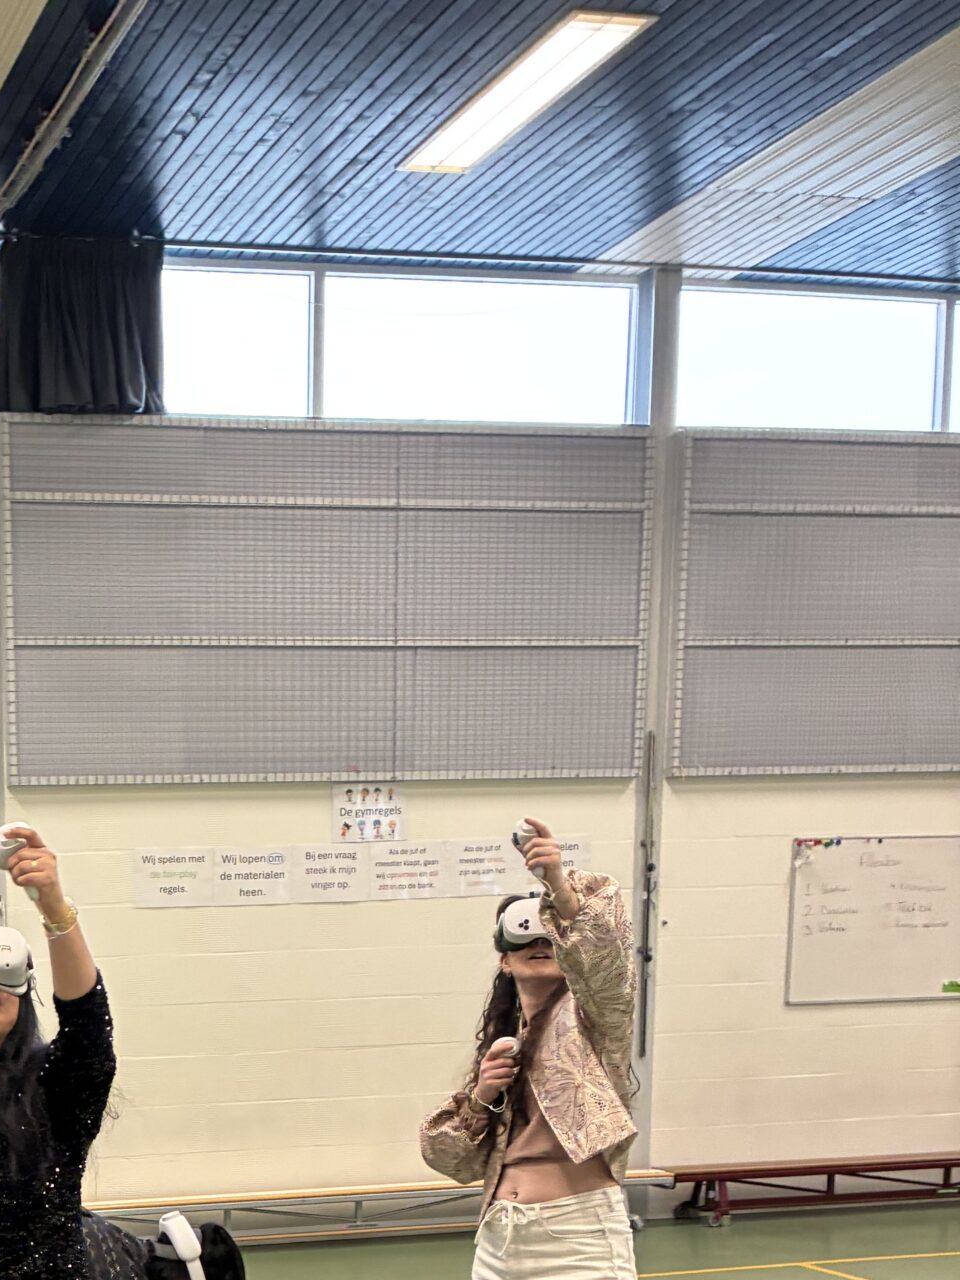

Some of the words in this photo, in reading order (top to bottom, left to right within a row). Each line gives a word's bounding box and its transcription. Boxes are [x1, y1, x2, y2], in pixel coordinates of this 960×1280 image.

[339, 807, 353, 817] De
[355, 805, 402, 818] gymregels
[141, 855, 156, 865] Wij
[157, 855, 187, 865] spelen
[188, 855, 205, 863] met
[221, 854, 237, 865] Wij
[239, 854, 266, 864] lopen
[268, 854, 284, 863] om
[305, 851, 316, 861] Bij
[317, 852, 333, 860] een
[334, 852, 357, 861] vraag
[220, 871, 232, 880] de
[234, 870, 285, 880] materialen
[338, 866, 356, 875] mijn
[159, 884, 188, 895] regels.
[311, 881, 336, 890] vinger
[239, 888, 267, 897] heen.
